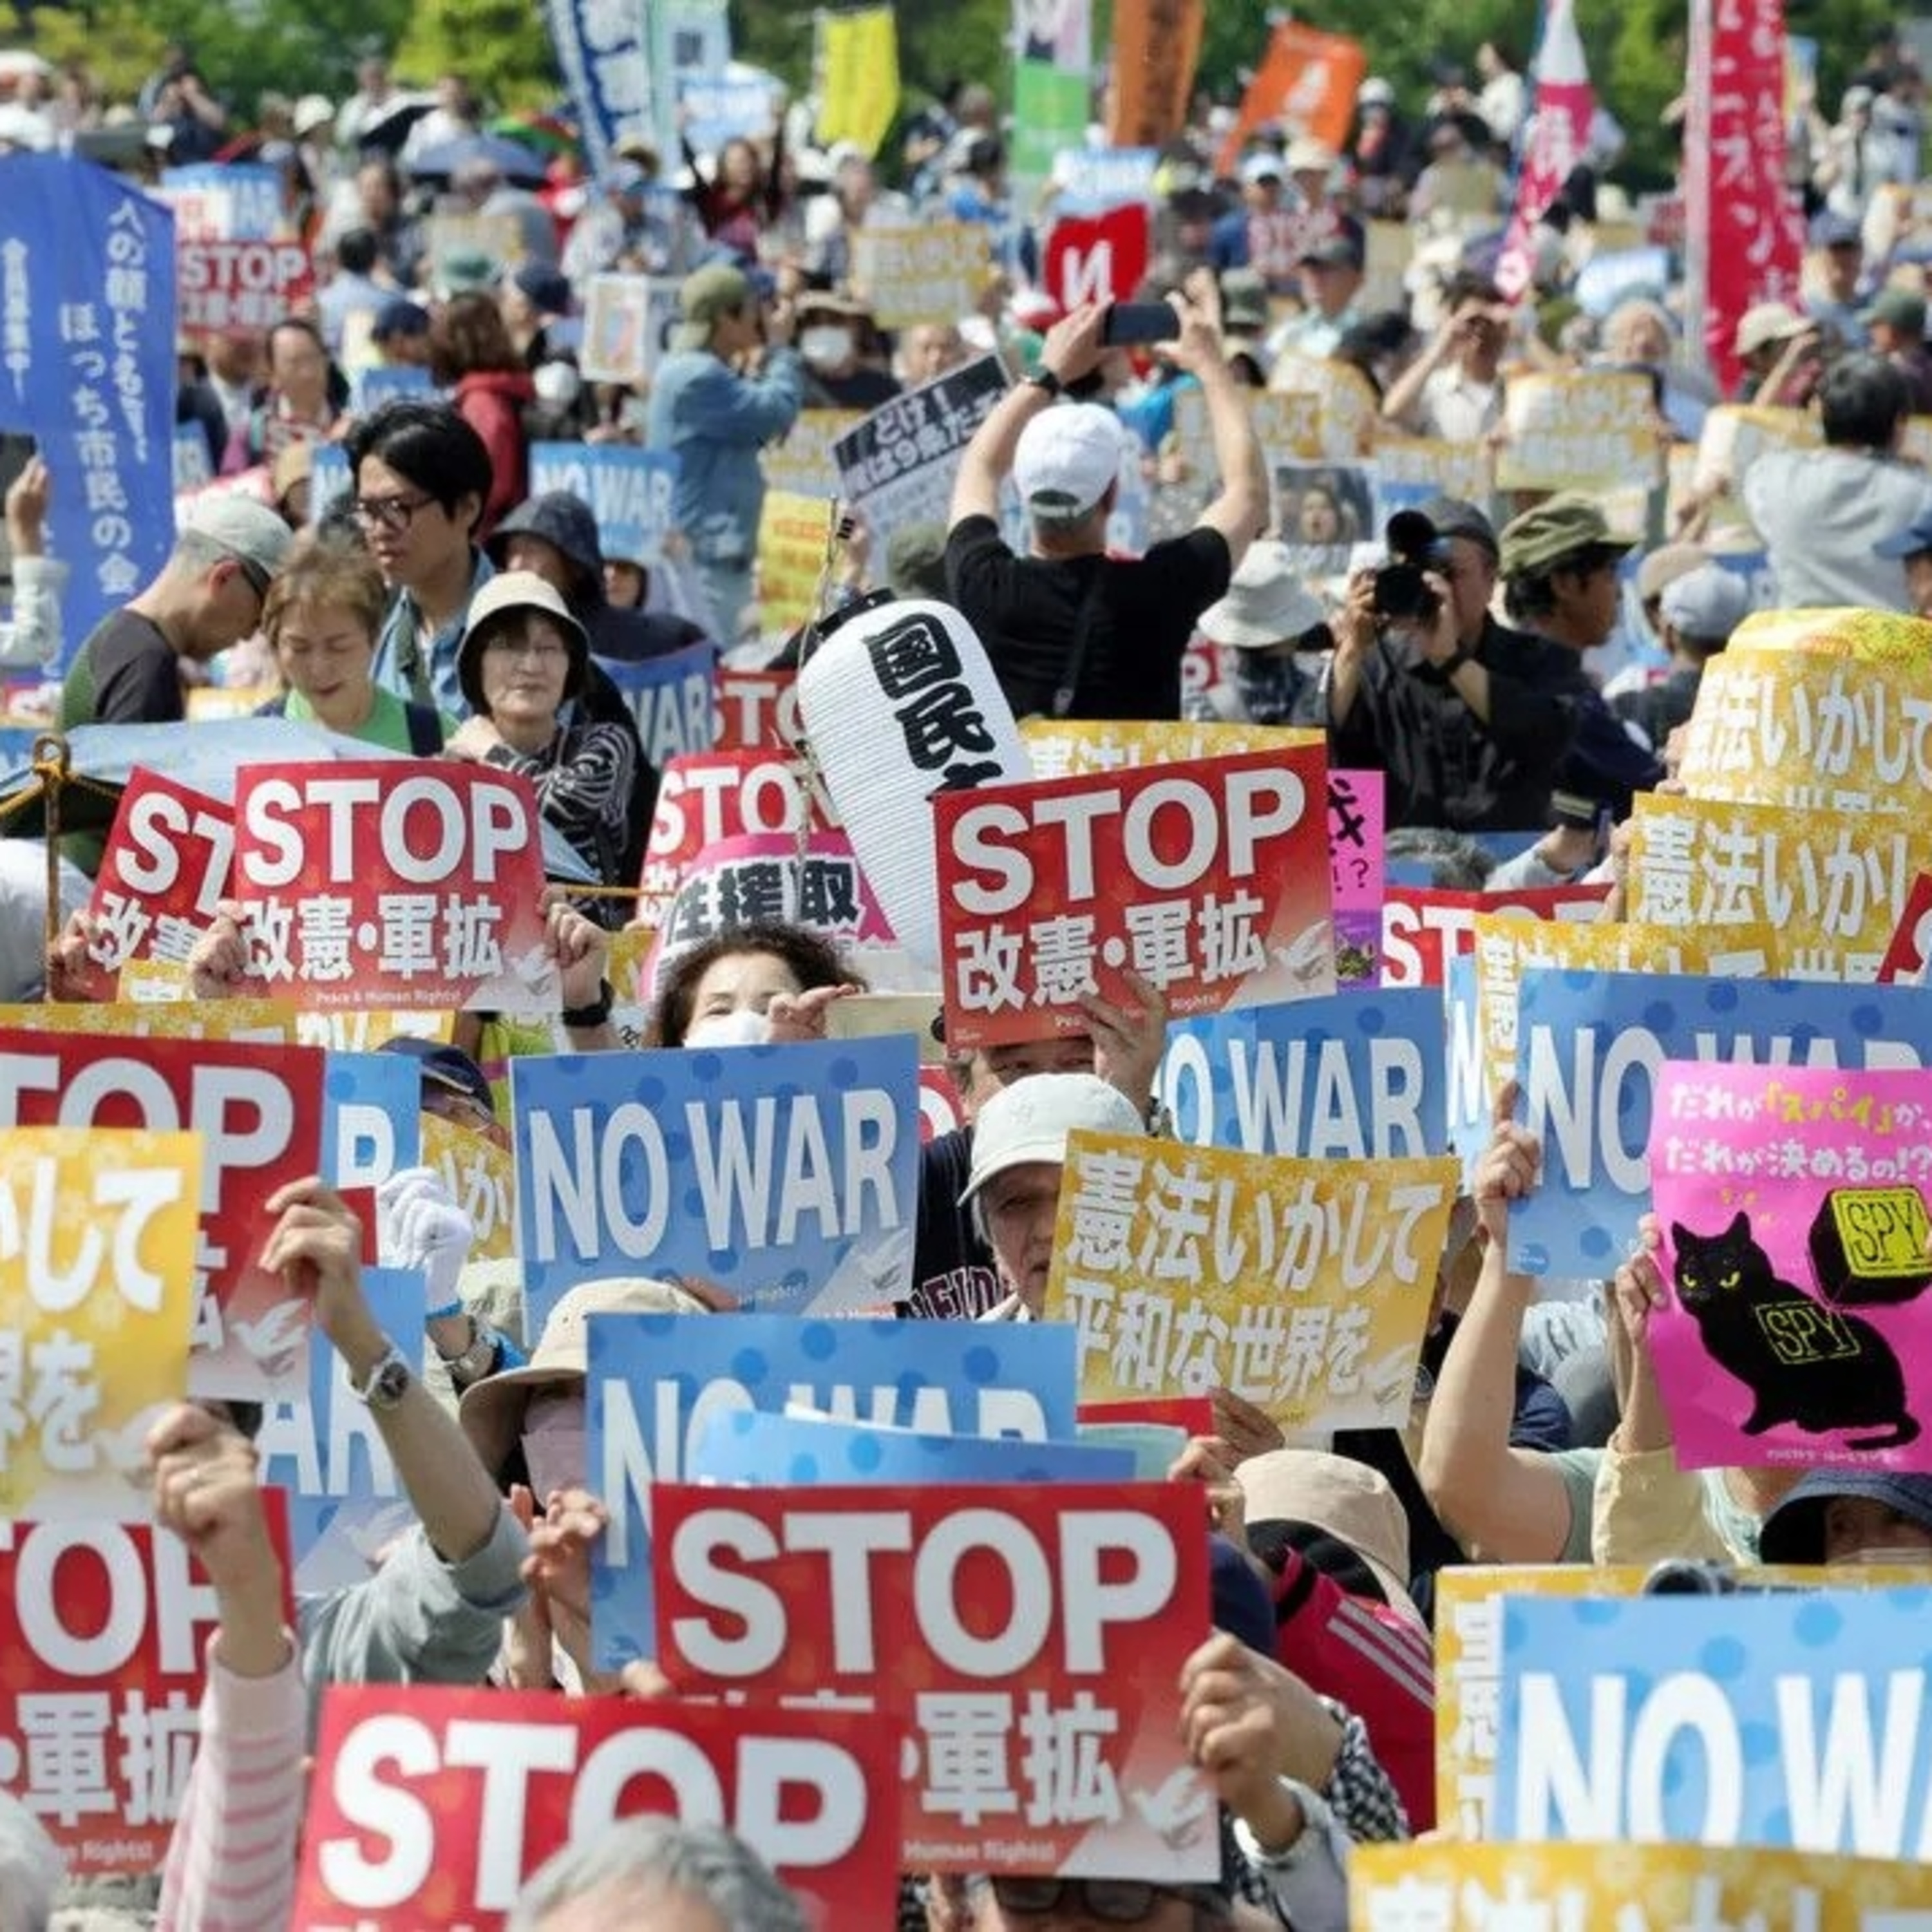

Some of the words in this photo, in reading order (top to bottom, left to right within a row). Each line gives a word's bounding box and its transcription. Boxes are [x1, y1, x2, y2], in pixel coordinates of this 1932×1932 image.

[181, 246, 307, 289] STOP
[592, 465, 673, 529] WAR
[242, 776, 531, 887] STOP
[951, 768, 1305, 914] STOP
[1228, 1036, 1430, 1159] WAR
[0, 1156, 183, 1314] して
[529, 1103, 670, 1262] NO
[685, 1088, 900, 1251] WAR
[1064, 1148, 1444, 1291] 憲法いかして
[1846, 1199, 1926, 1262] SPY
[1064, 1275, 1373, 1404] 平和な世界を
[1766, 1306, 1850, 1356] SPY
[671, 1508, 1177, 1676] STOP
[319, 1713, 867, 1911] STOP
[1517, 1671, 1743, 1844] NO
[1776, 1667, 1932, 1861] W
